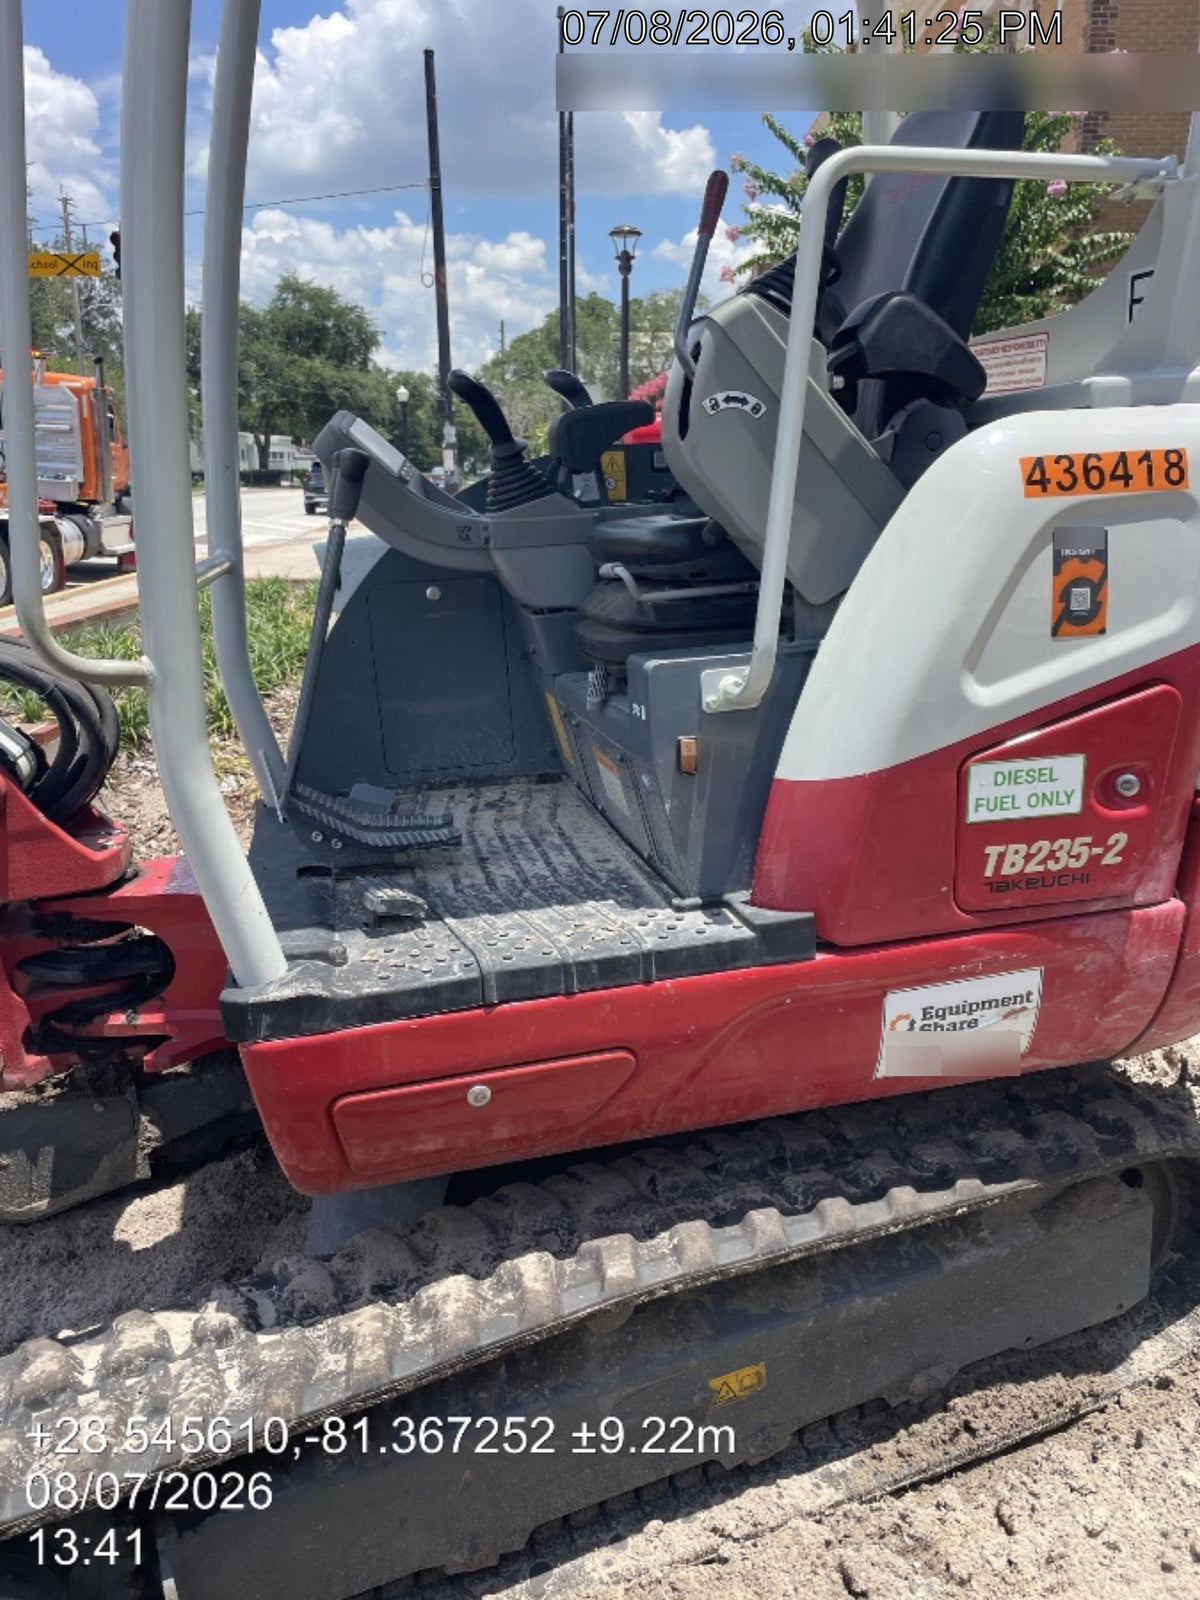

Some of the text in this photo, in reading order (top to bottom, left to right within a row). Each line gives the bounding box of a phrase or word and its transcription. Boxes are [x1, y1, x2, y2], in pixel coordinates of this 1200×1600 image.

[30, 259, 57, 269] chool
[1025, 449, 1185, 493] 436418
[993, 766, 1058, 787] DIESEL
[974, 789, 1076, 814] FUEL ONLY
[983, 831, 1129, 878] TB235-2
[920, 989, 1034, 1022] Equipment
